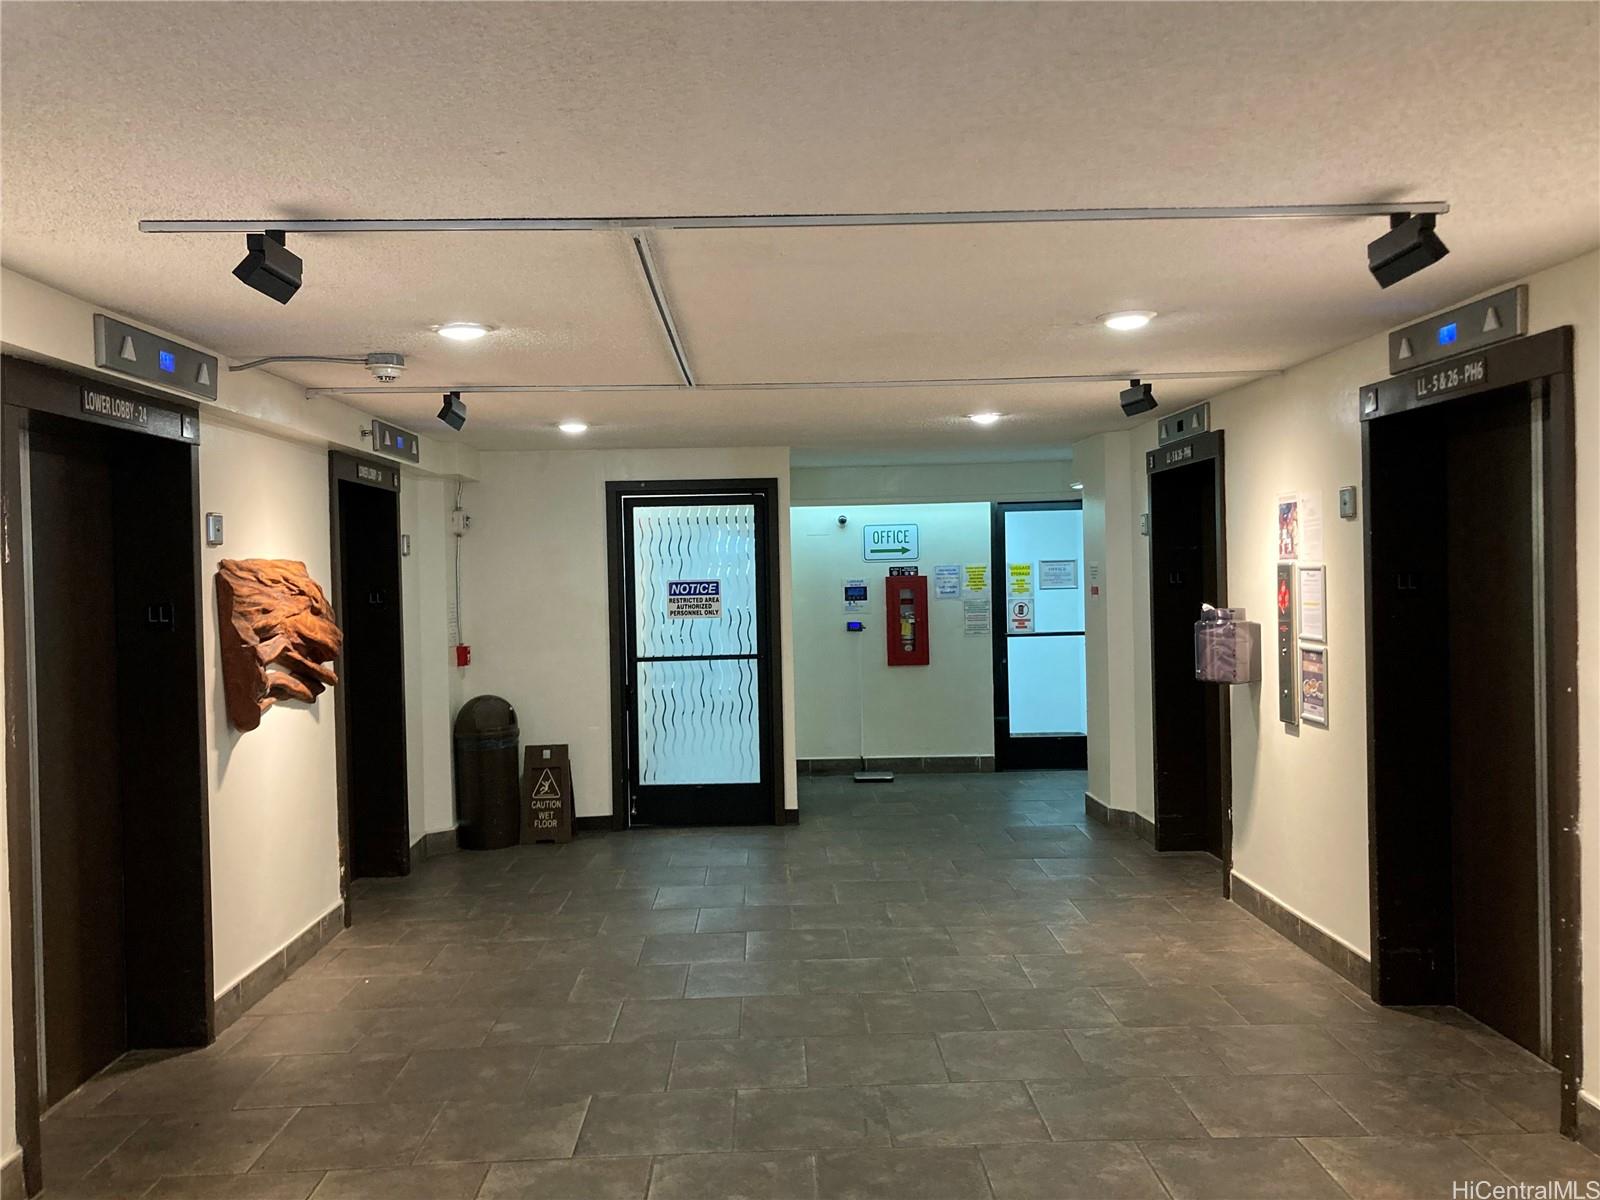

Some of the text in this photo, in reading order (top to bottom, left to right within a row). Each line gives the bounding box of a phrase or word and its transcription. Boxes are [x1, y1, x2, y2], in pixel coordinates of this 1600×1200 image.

[1417, 378, 1427, 396] LL
[1432, 375, 1438, 392] 5
[1440, 372, 1446, 389] &
[1447, 368, 1458, 387] 26
[1464, 361, 1484, 382] PH6
[84, 390, 111, 414] LOWER
[111, 399, 134, 420] LOBBY
[138, 405, 147, 424] 24
[1365, 391, 1376, 412] 2
[872, 529, 910, 545] OFFICE
[671, 583, 717, 594] NOTICE
[1396, 573, 1417, 591] LL
[368, 591, 384, 604] LL
[148, 605, 169, 623] LL
[531, 800, 562, 809] CAUTION
[538, 811, 554, 820] WET
[534, 820, 558, 828] FLOOR
